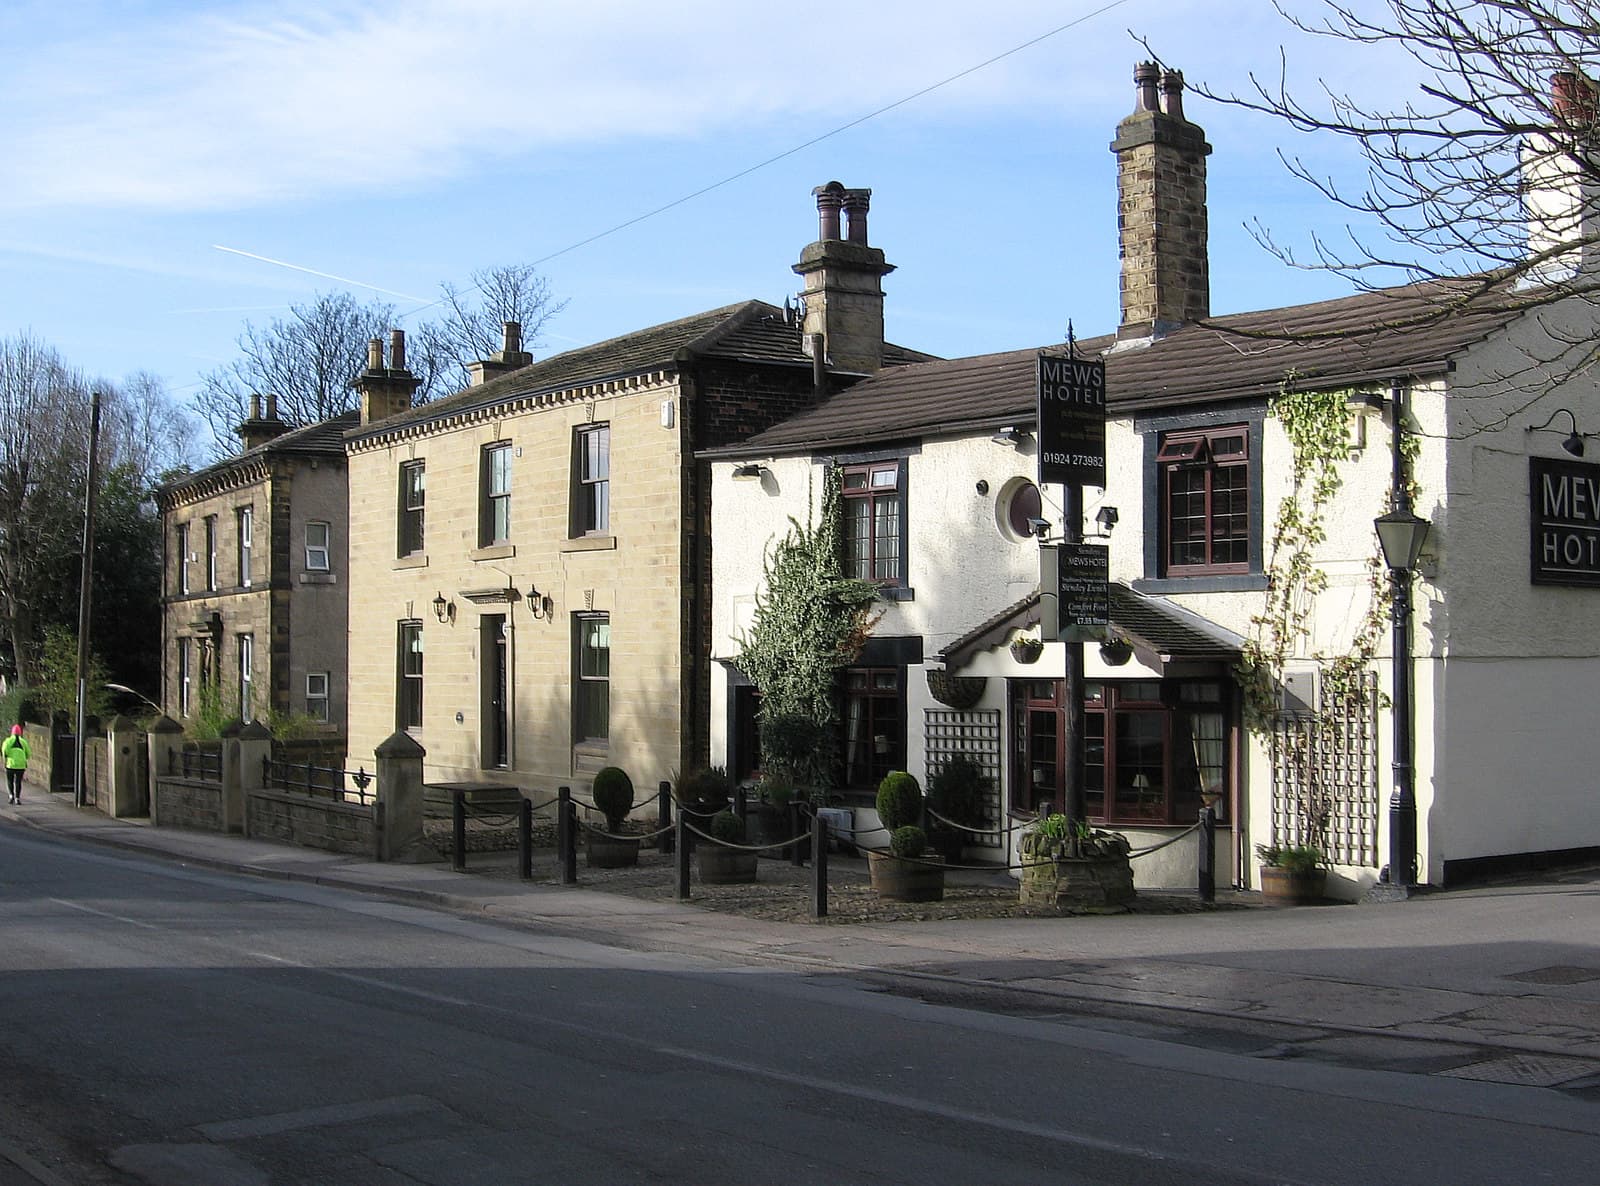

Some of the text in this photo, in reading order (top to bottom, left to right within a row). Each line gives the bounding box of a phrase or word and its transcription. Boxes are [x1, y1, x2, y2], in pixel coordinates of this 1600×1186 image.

[1043, 361, 1102, 387] MEWS
[1043, 384, 1103, 405] HOTEL
[1043, 452, 1070, 465] 01924
